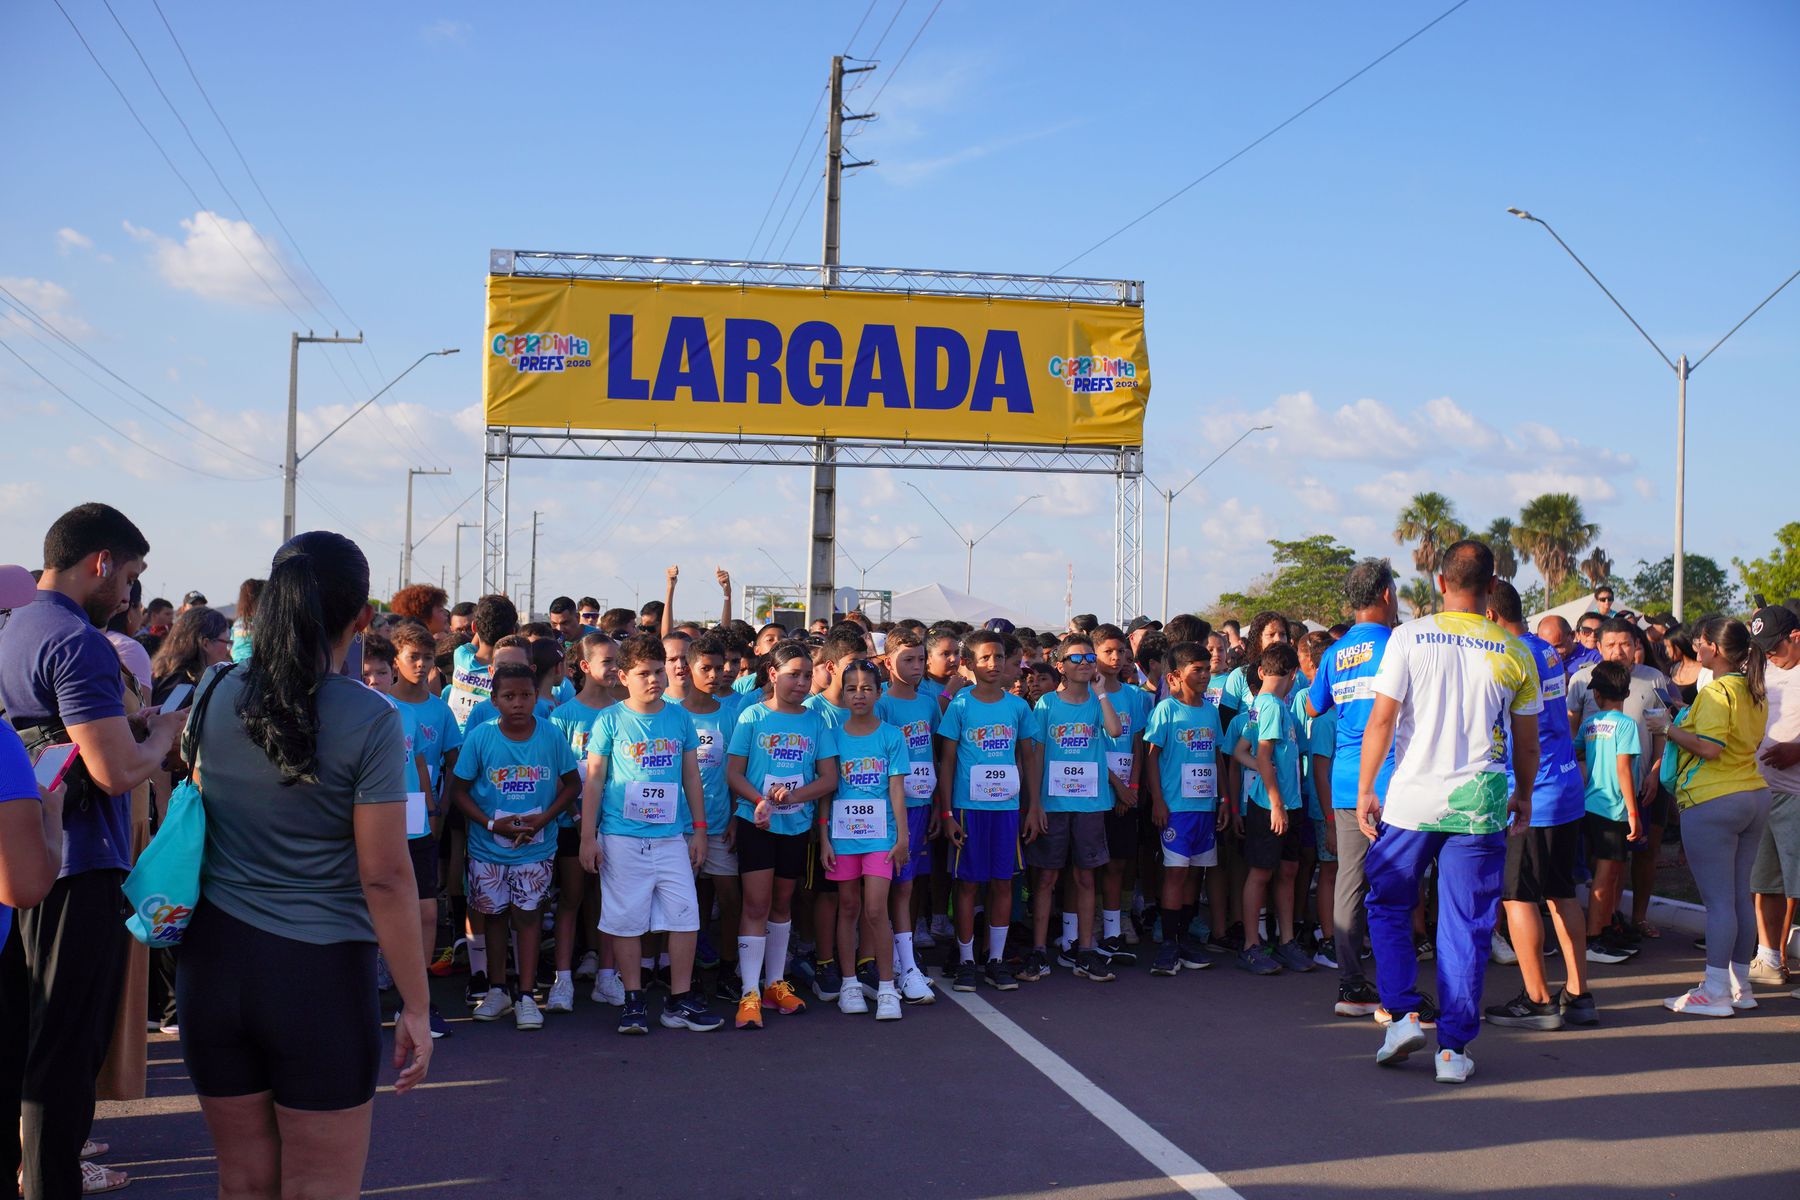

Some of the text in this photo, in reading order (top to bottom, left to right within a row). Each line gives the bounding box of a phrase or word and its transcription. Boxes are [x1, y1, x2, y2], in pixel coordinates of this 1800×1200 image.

[518, 355, 565, 371] PREFS
[607, 313, 1035, 414] LARGADA
[1073, 377, 1114, 391] PREFS
[1416, 632, 1505, 654] PROFESSOR
[1337, 641, 1375, 661] RUAS DE
[699, 735, 714, 745] 62
[982, 739, 1010, 750] PREFS
[1060, 737, 1089, 748] PREFS
[1190, 740, 1213, 751] PREFS
[772, 748, 804, 761] PREFS
[642, 755, 673, 768] PREFS
[914, 767, 930, 776] 412
[985, 770, 1006, 779] 299
[1064, 766, 1084, 775] 684
[1191, 768, 1212, 777] 1350
[849, 773, 880, 785] PREFS
[502, 781, 535, 793] PREFS
[770, 781, 798, 791] 87
[642, 788, 665, 798] 578
[844, 805, 874, 815] 1388
